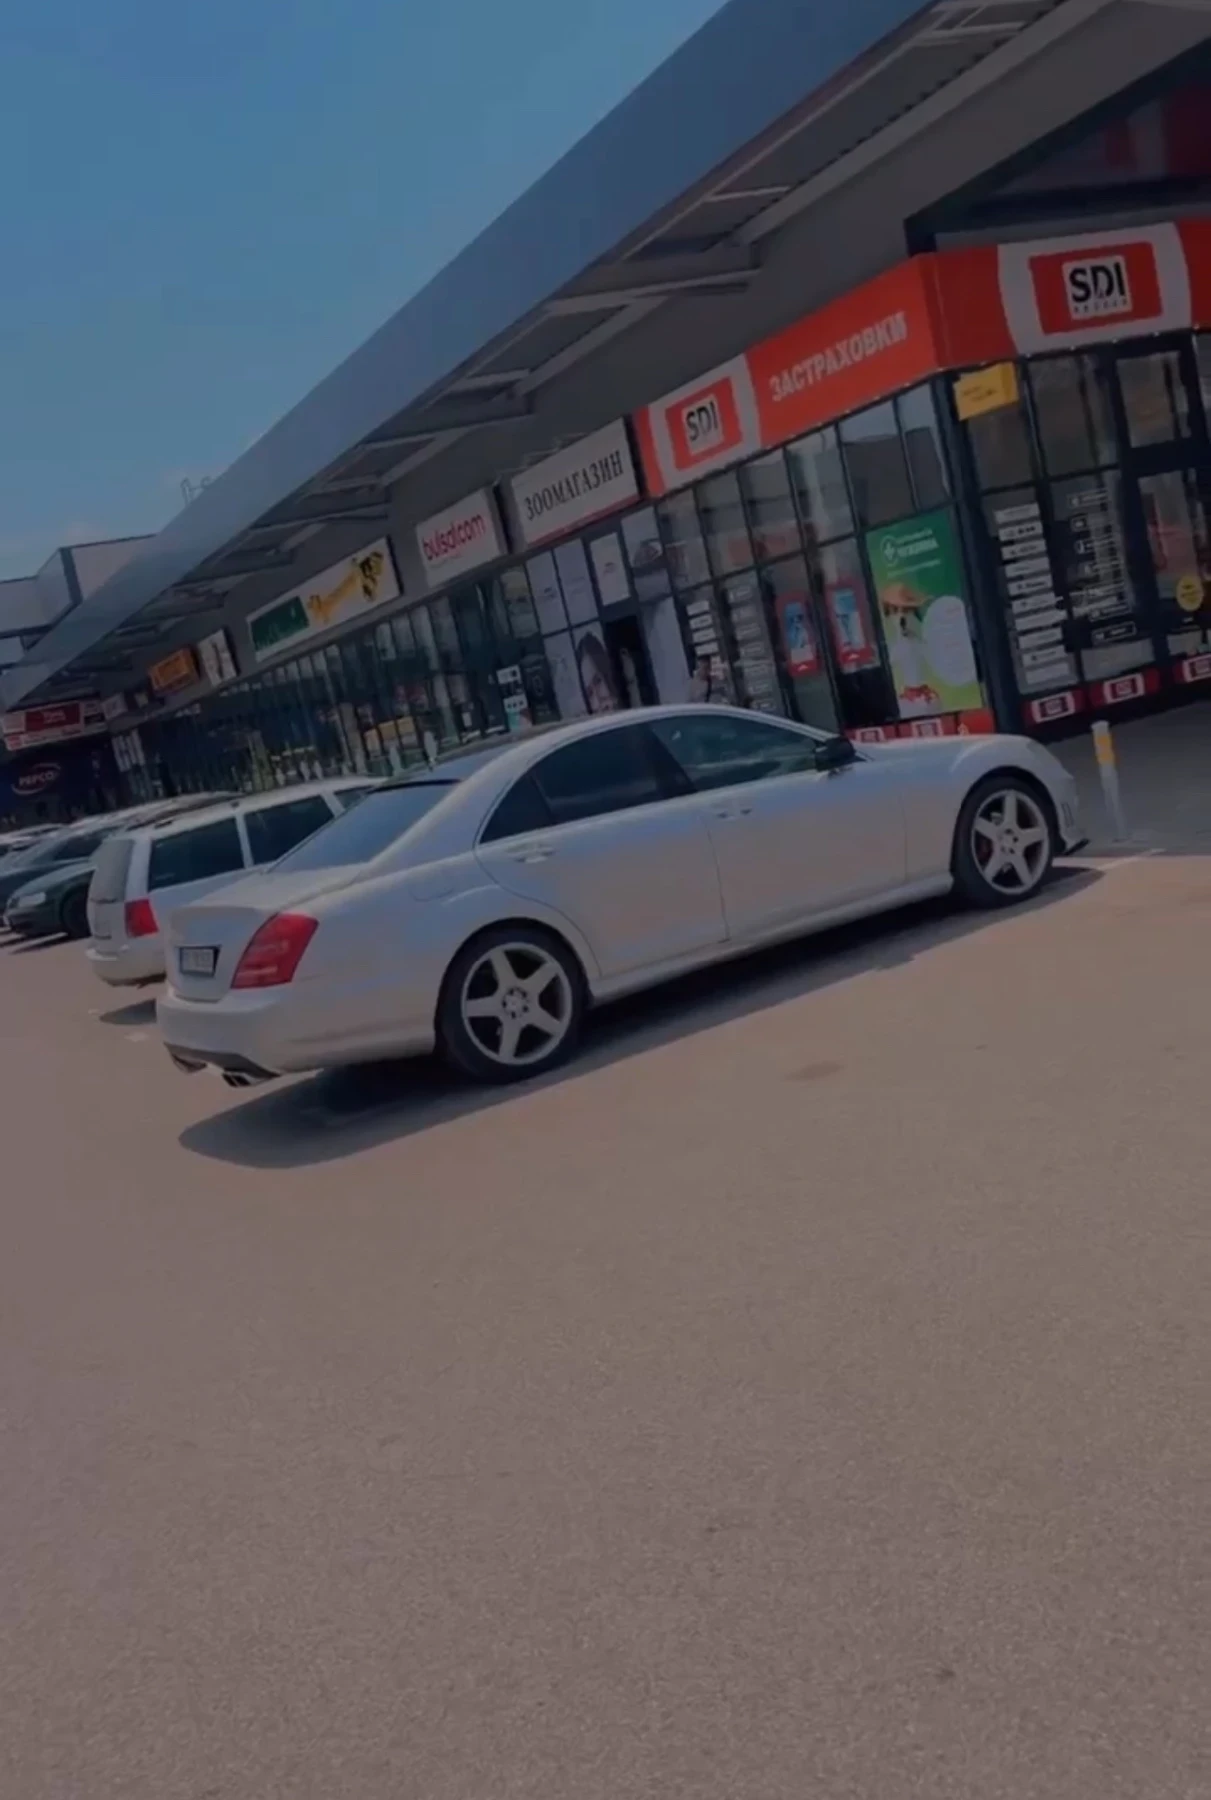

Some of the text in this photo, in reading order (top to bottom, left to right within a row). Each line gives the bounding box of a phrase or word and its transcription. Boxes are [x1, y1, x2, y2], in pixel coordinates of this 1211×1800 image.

[1069, 262, 1127, 304] SDI
[768, 311, 908, 402] ЗАСТРАХОВКИ
[685, 402, 719, 442] SDI
[524, 450, 624, 521] ЗООМАГАЗИН
